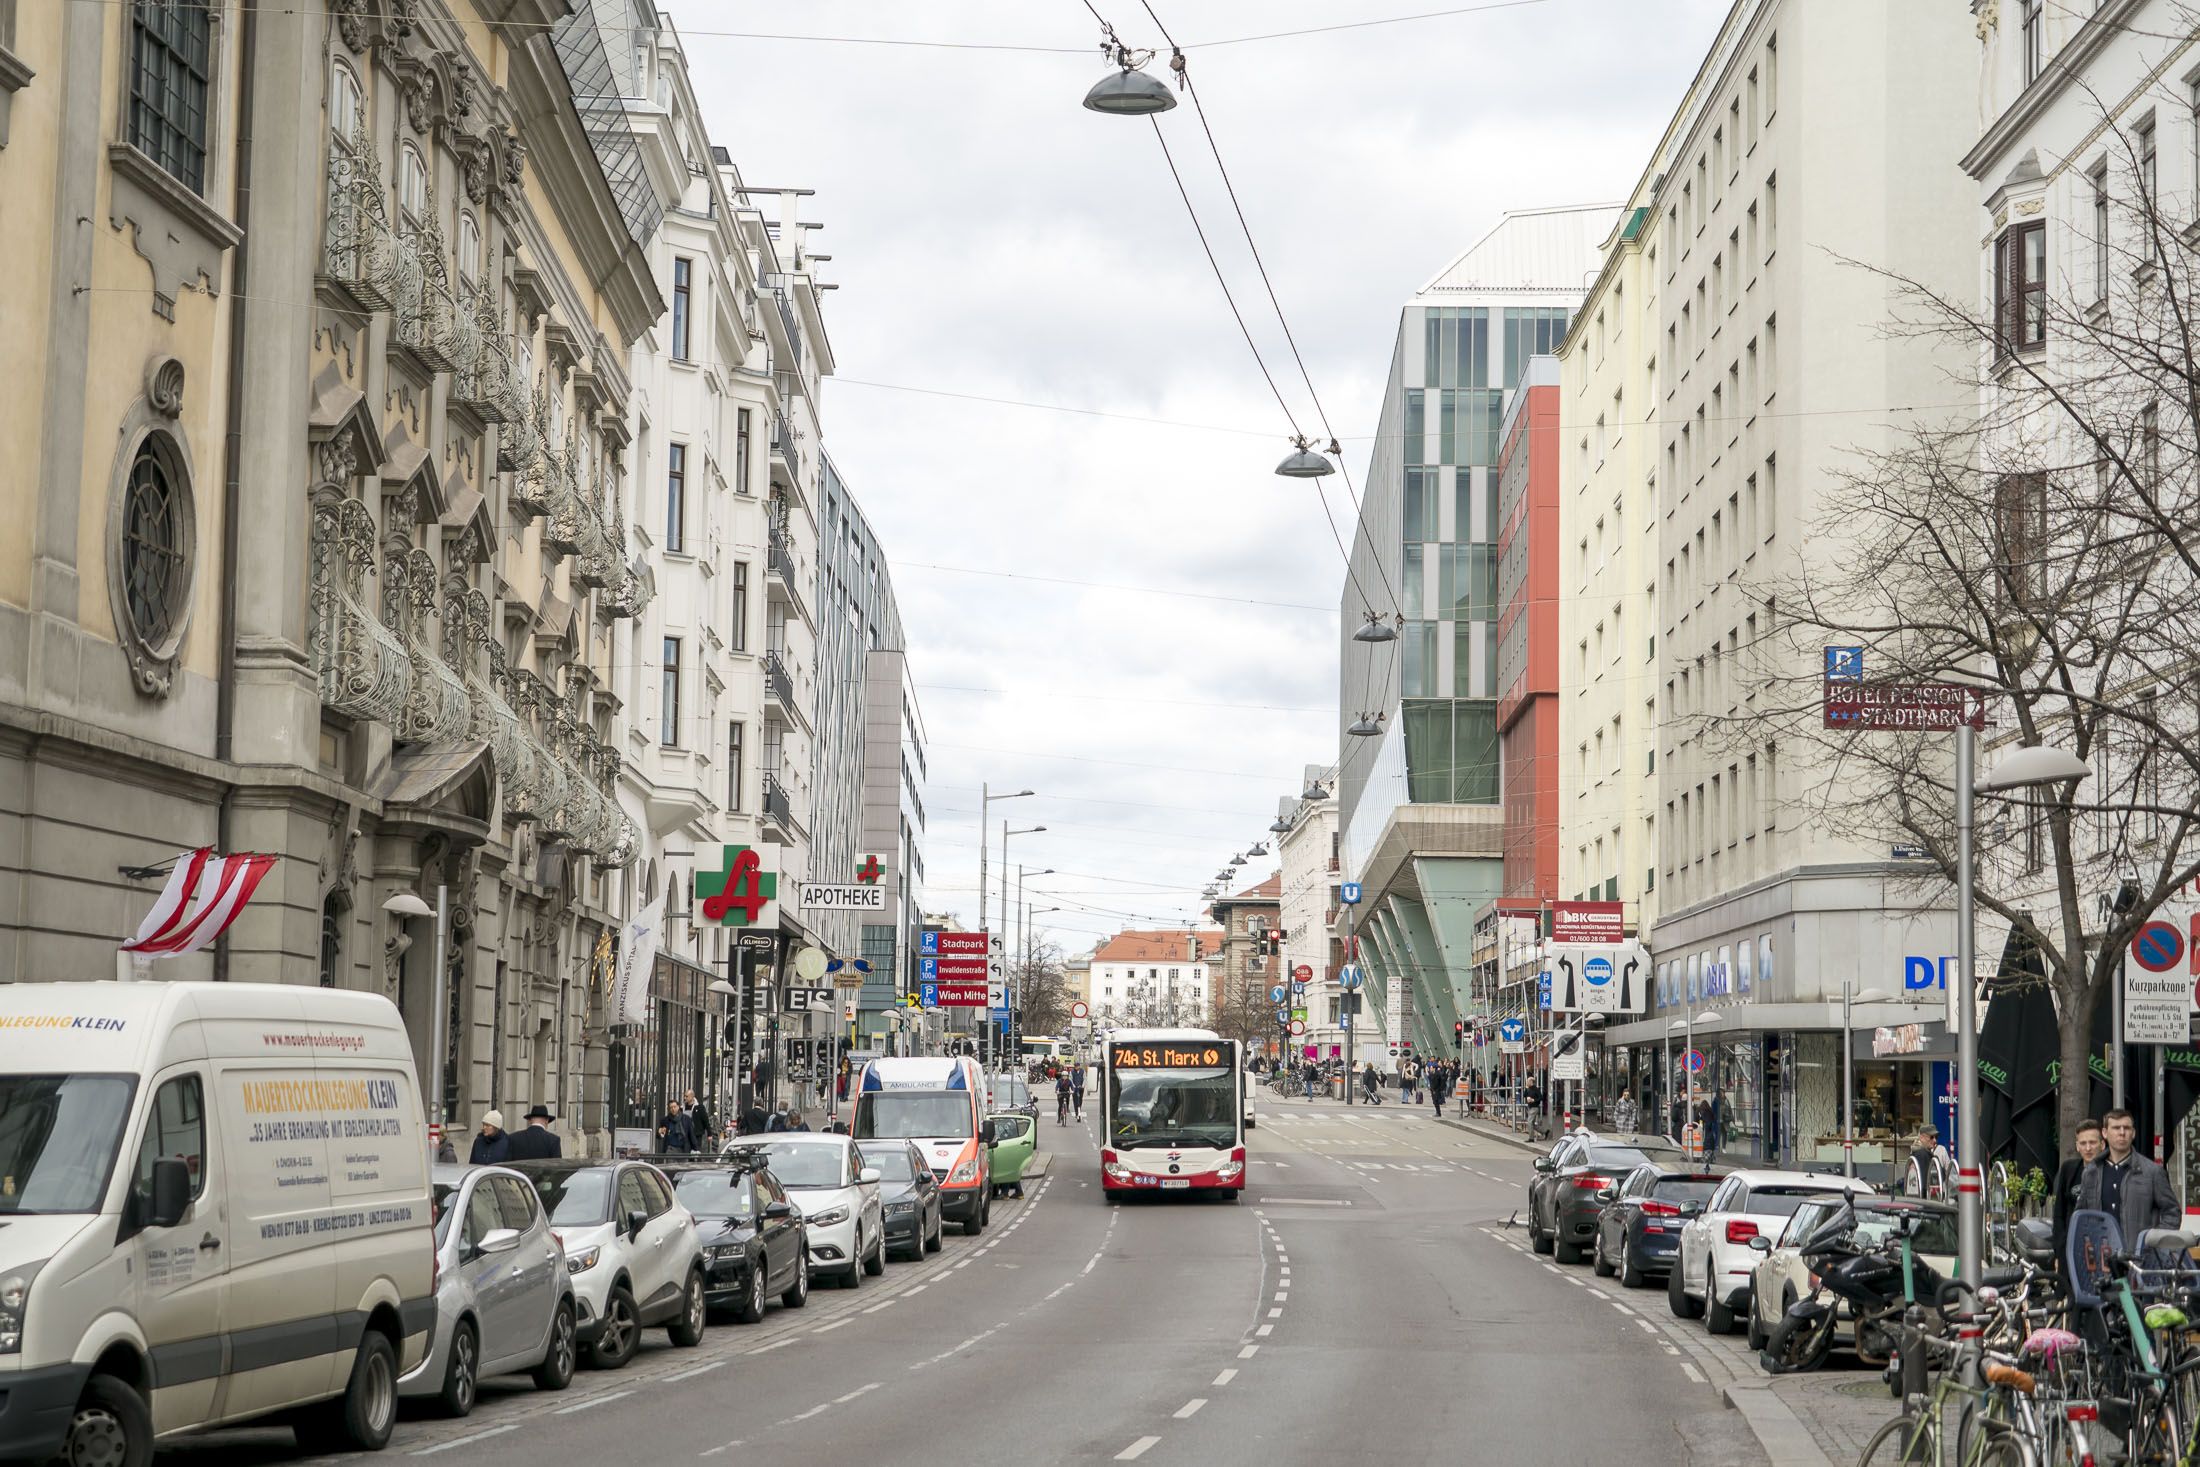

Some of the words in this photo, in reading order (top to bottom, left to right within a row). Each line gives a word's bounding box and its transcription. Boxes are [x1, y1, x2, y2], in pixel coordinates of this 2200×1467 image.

[1861, 708, 1963, 726] STADTPARK
[804, 888, 880, 906] APOTHEKE
[942, 939, 984, 949] Stadtpark
[626, 945, 637, 971] SPITAL
[939, 966, 985, 974] Invalidenstraße
[938, 991, 961, 1000] Wien
[964, 990, 986, 1000] Mitte
[2129, 978, 2186, 995] Kurzparkzone
[618, 970, 631, 1022] FRANZISKUS
[790, 989, 829, 1009] EIS
[2133, 1003, 2181, 1013] gebührenpflichtig
[263, 1031, 366, 1052] www.mauertrockenlegung.at
[1143, 1049, 1160, 1066] St.
[1164, 1049, 1199, 1066] Marx
[1977, 1058, 2008, 1082] uran
[890, 1081, 937, 1089] AMBULANCE
[265, 1121, 287, 1141] JAHRE
[288, 1120, 329, 1140] ERFAHRUNG
[331, 1120, 342, 1138] MIT
[345, 1118, 401, 1138] EDELSTAHLPLATTEN
[260, 1223, 276, 1239] WIEN
